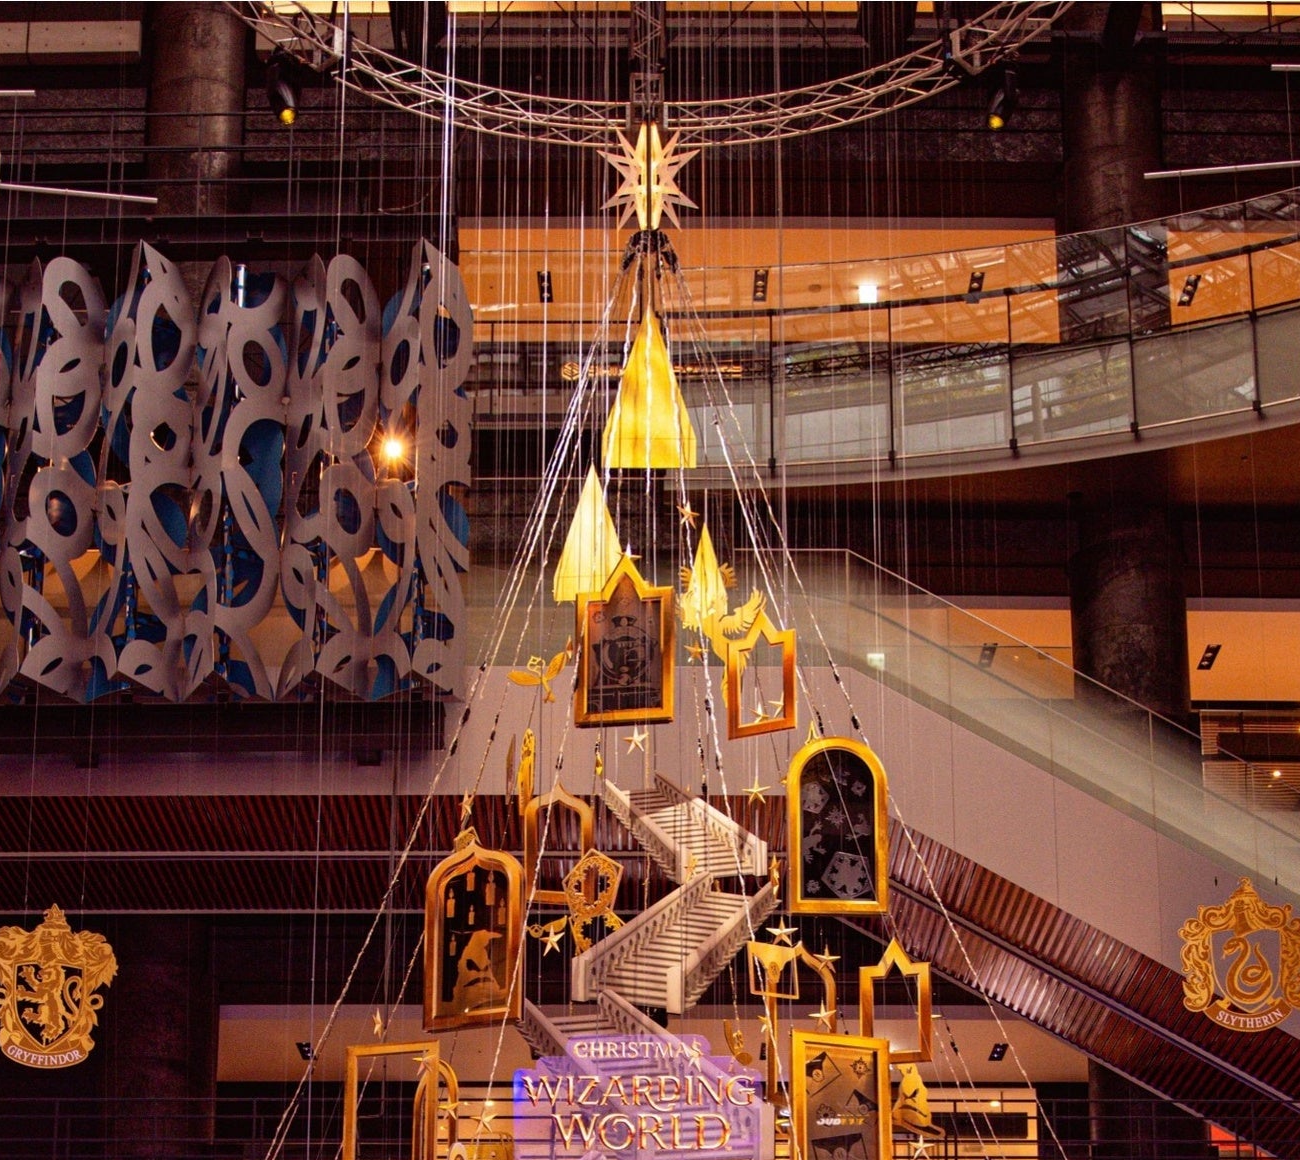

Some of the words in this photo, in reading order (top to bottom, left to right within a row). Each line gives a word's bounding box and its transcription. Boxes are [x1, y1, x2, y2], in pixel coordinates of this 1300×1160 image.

[1216, 1008, 1284, 1029] SLYTHERIN
[7, 1045, 83, 1066] GRYFFINDOR
[574, 1040, 703, 1060] CHRISTMAS
[521, 1074, 756, 1111] WIZARDING
[550, 1112, 732, 1151] WORLD
